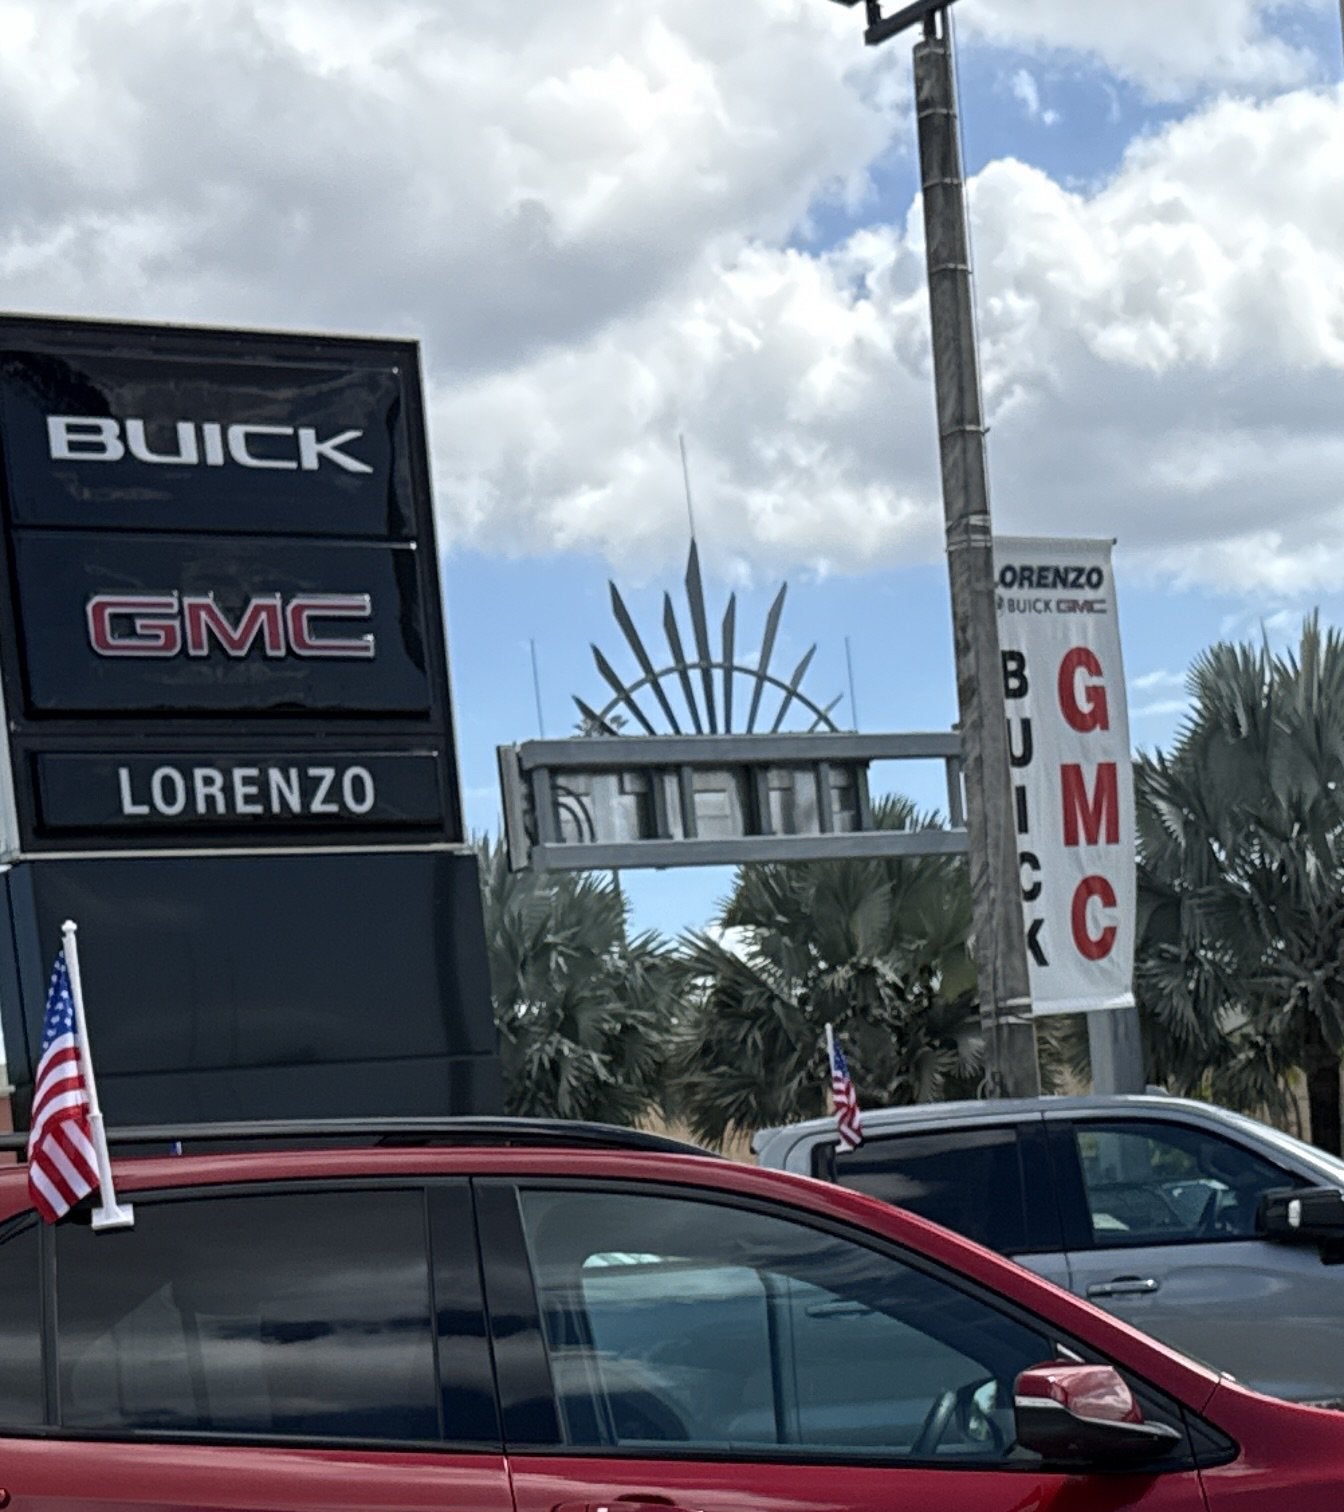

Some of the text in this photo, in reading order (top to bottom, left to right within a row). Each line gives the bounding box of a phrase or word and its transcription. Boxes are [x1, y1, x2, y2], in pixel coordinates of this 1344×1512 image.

[47, 415, 373, 473] BUICK
[998, 564, 1104, 589] ORENZO
[86, 592, 375, 657] GMC
[1008, 598, 1108, 615] BUICK GMC
[119, 766, 375, 815] LORENZO
[1000, 650, 1049, 967] BUICK
[1058, 646, 1120, 961] GMC
